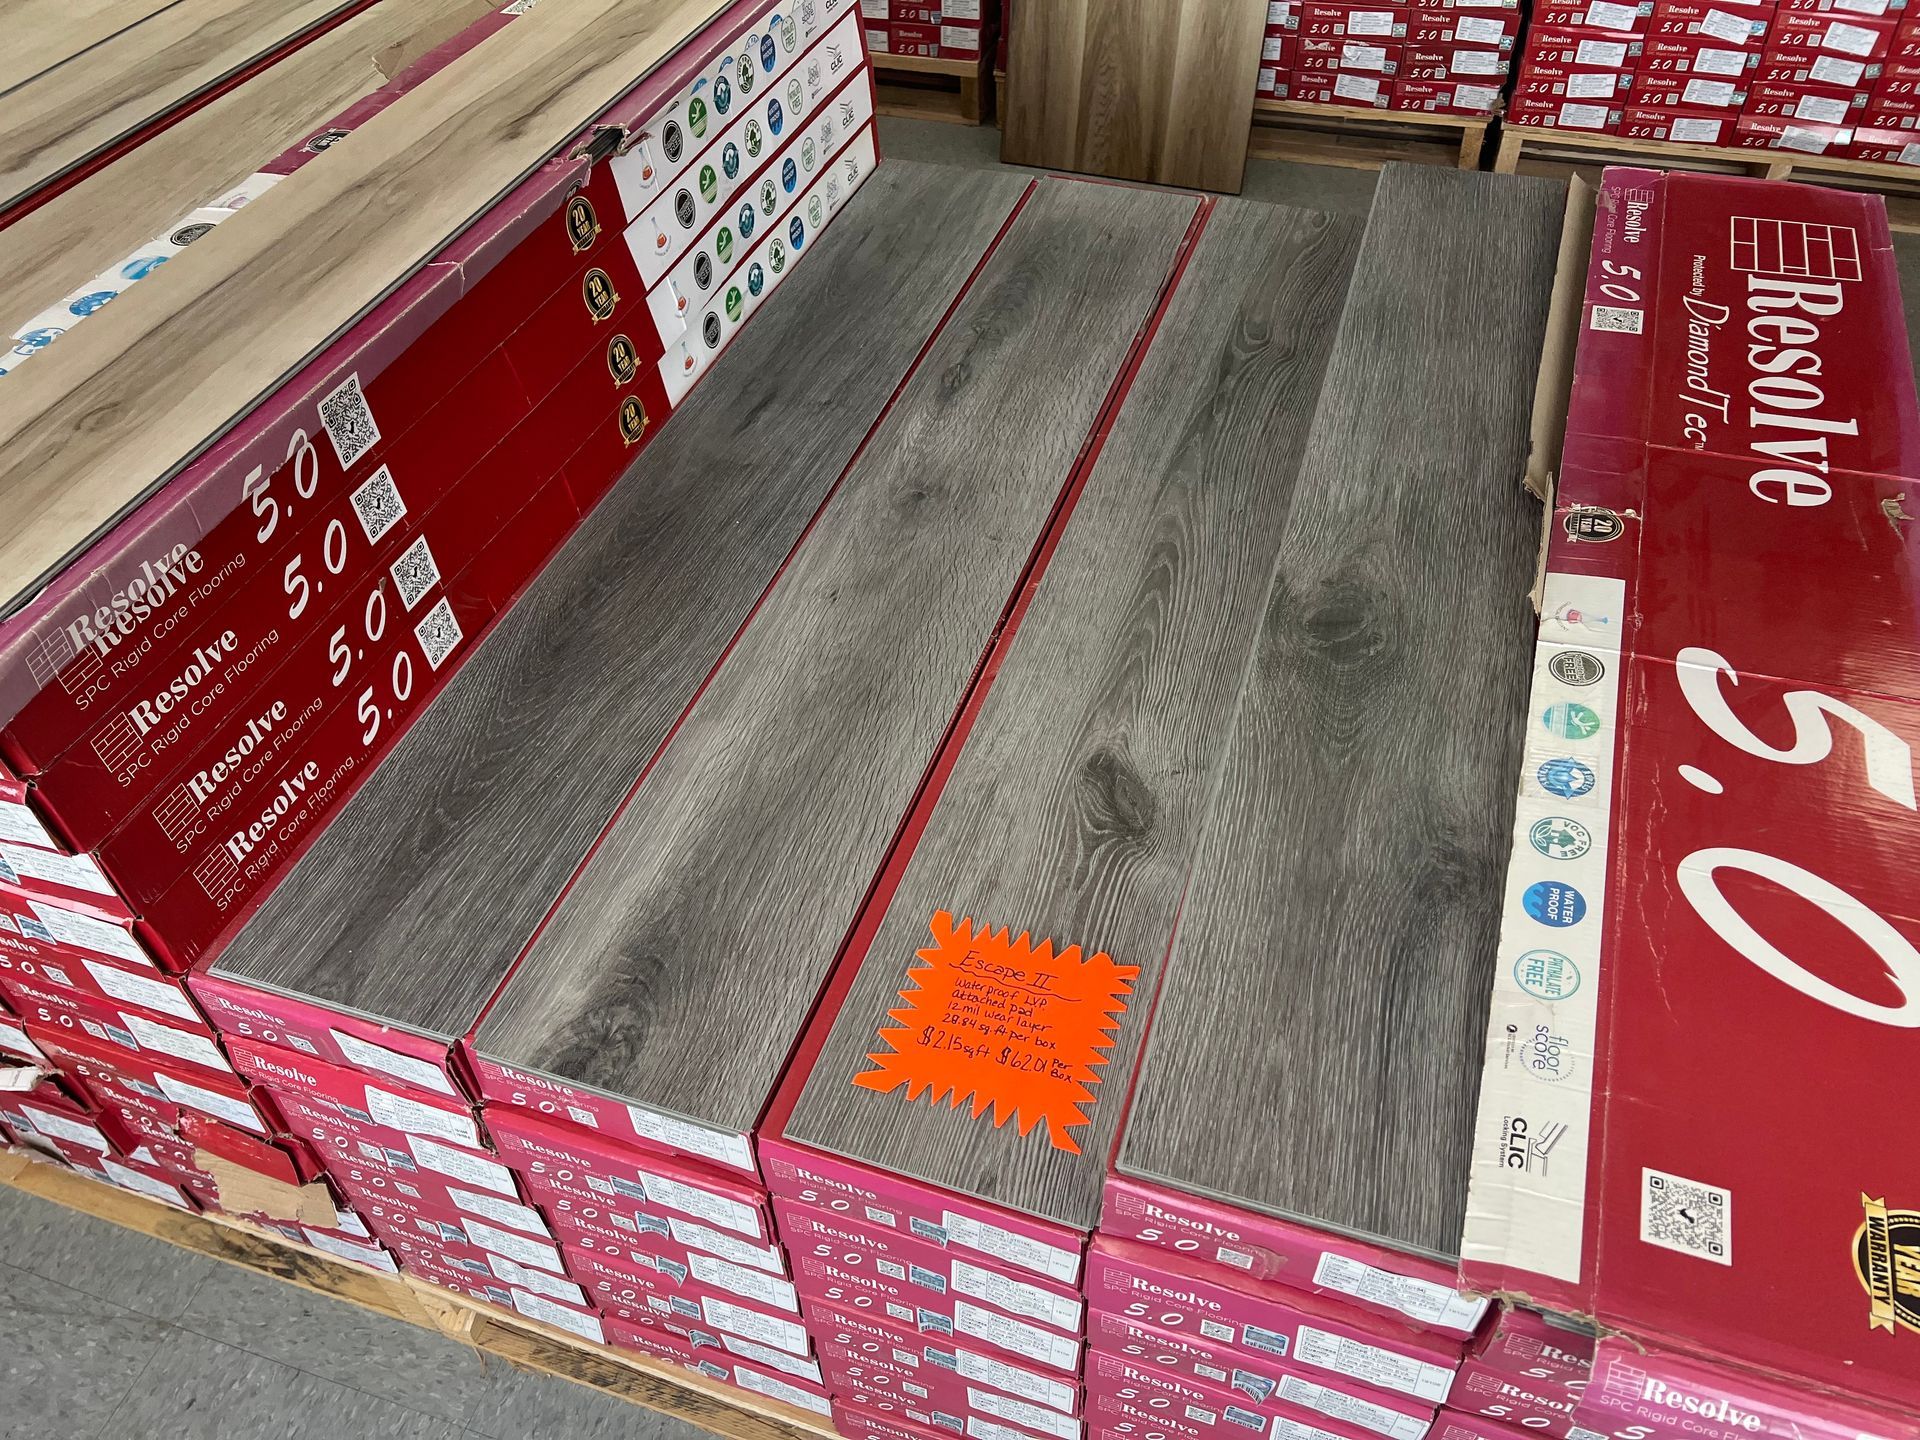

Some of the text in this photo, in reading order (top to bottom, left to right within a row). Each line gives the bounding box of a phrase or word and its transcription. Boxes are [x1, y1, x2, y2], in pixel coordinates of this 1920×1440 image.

[1422, 13, 1451, 24] Resolve
[1668, 5, 1700, 15] Resolve
[1788, 17, 1820, 27] Resolve
[1310, 24, 1330, 34] 5.0
[1780, 34, 1803, 44] 5.0
[1658, 43, 1688, 53] Resolve
[1775, 53, 1807, 63] Resolve
[1650, 60, 1672, 70] 5.0
[1405, 84, 1433, 94] Resolve
[1647, 77, 1677, 87] Resolve
[1763, 88, 1794, 97] Resolve
[1525, 99, 1554, 109] Resolve
[1636, 110, 1666, 120] Resolve
[1883, 100, 1915, 110] Resolve
[1519, 115, 1539, 125] 5.0
[1751, 123, 1781, 132] Resolve
[1874, 116, 1898, 126] 5.0
[572, 205, 586, 226] 20
[1623, 201, 1649, 243] Resolve
[577, 220, 591, 238] YEAR
[1600, 260, 1642, 302] 5.0
[1692, 254, 1706, 287] Protected
[588, 276, 602, 298] 20
[594, 290, 609, 308] YEAR
[613, 342, 626, 363] 20
[618, 355, 631, 372] YEAR
[1747, 274, 1859, 507] Resolve
[624, 403, 635, 424] 20
[628, 415, 640, 432] YEAR
[252, 441, 319, 544] 5.0
[1593, 518, 1613, 533] 20
[284, 518, 347, 620] 5.0
[75, 552, 246, 711] SPC Rigid Core Flooring
[329, 589, 386, 687] 5.0
[1564, 657, 1578, 681] FREE
[128, 629, 238, 737] Resolve
[117, 628, 280, 788] SPC Rigid Core Flooring
[357, 651, 413, 746] 5.0
[186, 700, 287, 805] Resolve
[176, 696, 323, 854] SPC Rigid Core Flooring
[225, 760, 320, 864] Resolve
[216, 755, 355, 912] SPC Rigid Core Flooring
[1563, 821, 1586, 838] VOC
[1676, 647, 1920, 1028] 5.0
[1560, 839, 1587, 858] FREE
[1548, 887, 1560, 921] PROOF
[1562, 890, 1575, 924] WATER
[960, 950, 1059, 992] Escape II
[1526, 957, 1544, 988] FREE
[1545, 956, 1564, 996] PHTHALATE
[18, 983, 79, 1009] Resolve
[952, 989, 1033, 1018] attached pad
[37, 1008, 73, 1029] 5.0
[218, 998, 286, 1027] Resolve
[948, 1000, 1053, 1034] 12 mil wear layer
[238, 1022, 278, 1043] 5.0
[942, 1012, 977, 1028] 28.84
[994, 1024, 1008, 1036] ft
[1007, 1030, 1030, 1045] per
[1035, 1036, 1057, 1050] box
[916, 1025, 963, 1051] $2.15
[995, 1046, 1048, 1073] $62.01
[1532, 1024, 1549, 1070] score
[1547, 1036, 1569, 1075] floor
[252, 1056, 317, 1087] Resolve
[1050, 1068, 1073, 1084] Box
[1052, 1058, 1073, 1070] Per
[258, 1072, 339, 1104] Rigid Core Flooring
[500, 1066, 574, 1097] Resolve
[511, 1093, 555, 1114] 5.0
[299, 1103, 361, 1134] Resolve
[312, 1127, 349, 1148] 5.0
[1499, 1116, 1511, 1168] Locking System
[1507, 1117, 1528, 1169] CLIC
[337, 1148, 397, 1176] Resolve
[520, 1138, 592, 1168] Resolve
[350, 1169, 386, 1188] 5.0
[530, 1161, 574, 1181] 5.0
[796, 1167, 877, 1200] Resolve
[360, 1186, 418, 1213] Resolve
[548, 1177, 616, 1207] Resolve
[799, 1189, 850, 1210] 5.0
[371, 1205, 407, 1224] 5.0
[556, 1200, 598, 1218] 5.0
[573, 1216, 638, 1245] Resolve
[811, 1220, 889, 1251] Resolve
[1144, 1216, 1177, 1231] Rigid
[1180, 1227, 1211, 1240] Core
[1145, 1204, 1241, 1242] Resolve
[580, 1237, 620, 1256] 5.0
[1136, 1228, 1200, 1251] 5.0
[813, 1244, 862, 1265] 5.0
[1868, 1215, 1891, 1306] WARRANTY
[591, 1261, 656, 1289] Resolve
[825, 1265, 899, 1295] Resolve
[1893, 1244, 1920, 1298] YEAR
[597, 1281, 636, 1299] 5.0
[825, 1287, 872, 1307] 5.0
[1131, 1290, 1162, 1305] Rigid
[1132, 1277, 1222, 1312] Resolve
[1123, 1302, 1184, 1326] 5.0
[833, 1313, 904, 1343] Resolve
[834, 1333, 880, 1352] 5.0
[1122, 1344, 1178, 1365] 5.0
[1127, 1325, 1213, 1360] Resolve
[1123, 1367, 1204, 1400] Resolve
[1116, 1388, 1171, 1408] 5.0
[1496, 1393, 1531, 1409] Rigid
[1643, 1376, 1762, 1433] Resolve
[1121, 1403, 1199, 1436] Resolve
[1480, 1405, 1550, 1428] 5.0
[1600, 1395, 1720, 1439] SPC Rigid Core
[1113, 1422, 1166, 1440] 5.0
